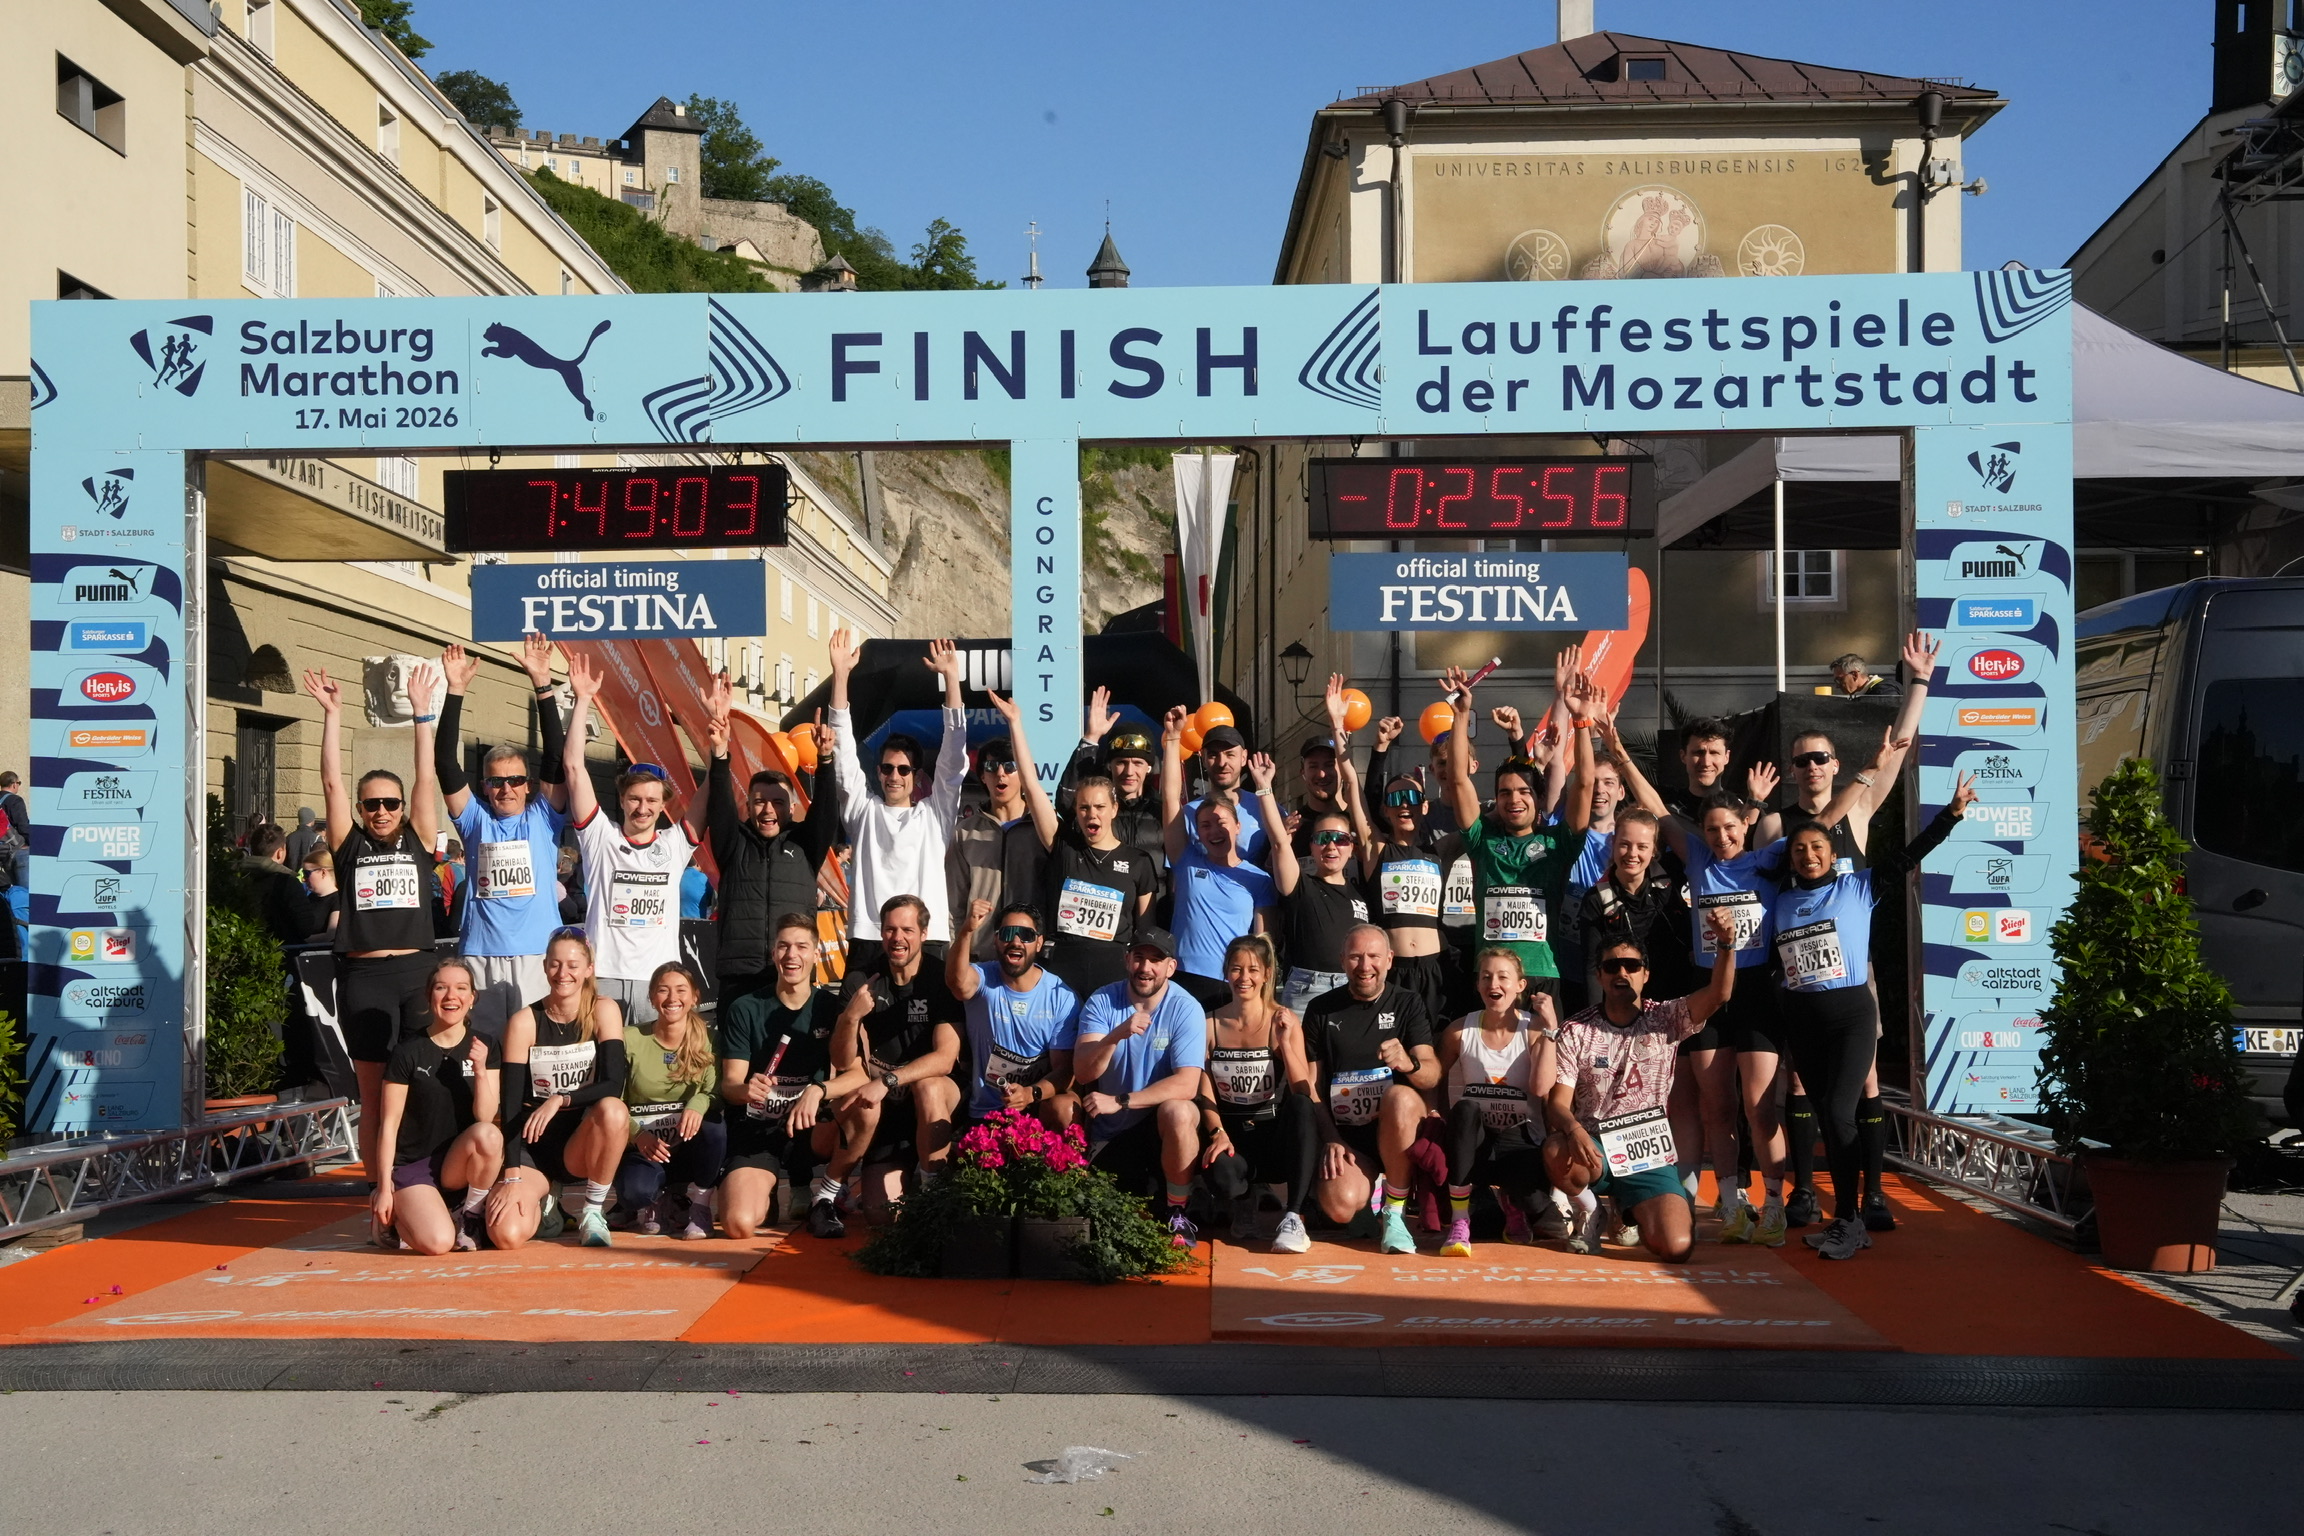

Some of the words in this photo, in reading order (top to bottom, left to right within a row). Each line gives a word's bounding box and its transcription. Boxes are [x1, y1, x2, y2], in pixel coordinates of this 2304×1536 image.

[1435, 162, 1585, 177] UNIVERSITAS
[1605, 158, 1797, 175] SALISBURGENSIS
[1824, 157, 1860, 173] 162
[1417, 298, 1955, 362] Lauffestspiele
[240, 319, 434, 362] Salzburg
[831, 326, 1258, 402] FINISH
[240, 362, 460, 396] Marathon
[1415, 365, 1529, 414] der
[1562, 355, 2038, 411] Mozartstadt
[295, 408, 330, 430] 17.
[338, 407, 387, 429] Mai
[396, 406, 459, 429] 2026
[349, 482, 445, 545] FELSENREITSCH
[528, 475, 759, 538] 7:49:03
[1965, 504, 1990, 512] STADT
[1396, 558, 1467, 579] official
[1474, 558, 1540, 583] timing
[1962, 561, 2016, 578] PUMA
[537, 568, 607, 590] official
[614, 568, 679, 592] timing
[76, 584, 128, 602] PUMA
[1036, 496, 1055, 722] CONGRATS
[1380, 585, 1578, 622] FESTINA
[521, 593, 718, 634] FESTINA
[1974, 656, 2020, 674] Hervis
[86, 679, 131, 695] Hervis
[1974, 768, 2022, 778] FESTINA
[83, 790, 132, 800] FESTINA
[1964, 806, 2032, 822] POWER
[72, 826, 140, 842] POWER
[1995, 822, 2032, 836] ADE
[102, 842, 140, 857] ADE
[356, 853, 414, 864] POWERADE
[492, 857, 527, 868] ARCHIBALD
[377, 868, 414, 877] KATHARINA
[1388, 862, 1429, 872] SPARKASSE
[491, 866, 532, 886] 10408
[615, 872, 668, 882] POWERADE
[376, 878, 406, 896] 8093
[408, 878, 416, 896] C
[644, 890, 660, 898] MARC
[1486, 886, 1544, 896] POWERADE
[1401, 886, 1437, 905] 3960
[1699, 893, 1757, 905] POWERADE
[1080, 898, 1117, 912] FRIEDERIKE
[1507, 902, 1539, 910] MAURICIO
[1076, 907, 1114, 930] 3961
[1502, 911, 1532, 928] 8095
[1536, 912, 1544, 930] C
[2000, 918, 2025, 932] Stiegl
[1776, 922, 1834, 943] POWERADE
[106, 937, 130, 951] Stiegl
[1800, 938, 1828, 952] JESSICA
[1796, 948, 1830, 974] 8094
[1830, 946, 1842, 966] B
[1987, 968, 2041, 978] altstadt
[91, 986, 144, 996] altstadt
[1982, 979, 2042, 992] salzburg
[85, 997, 144, 1010] salzburg
[1961, 1032, 2020, 1048] CUP&CINO
[2246, 1030, 2270, 1050] KE
[62, 1050, 121, 1066] CUP&CINO
[1212, 1050, 1269, 1059] POWERADE
[552, 1060, 592, 1072] ALEXANDRA
[1236, 1065, 1265, 1074] SABRINA
[552, 1068, 592, 1088] 10407
[1231, 1076, 1261, 1093] 8092
[1264, 1074, 1272, 1090] D
[1357, 1086, 1384, 1096] CYRILLE
[1464, 1086, 1523, 1097] POWERADE
[630, 1102, 684, 1113] POWERADE
[1490, 1103, 1515, 1112] NICOLE
[656, 1118, 677, 1128] RABIA
[1600, 1108, 1662, 1130] POWERADE
[1622, 1128, 1649, 1142] MANUEL
[1649, 1123, 1668, 1136] MELO
[1626, 1138, 1660, 1160] 8095
[1660, 1134, 1672, 1152] D
[1391, 1267, 1770, 1277] Lauffestspiele
[1484, 1276, 1782, 1284] Mozartstadt
[519, 1308, 680, 1316] Weiss
[1402, 1316, 1658, 1324] Gebrüder
[1674, 1318, 1832, 1326] Weiss
